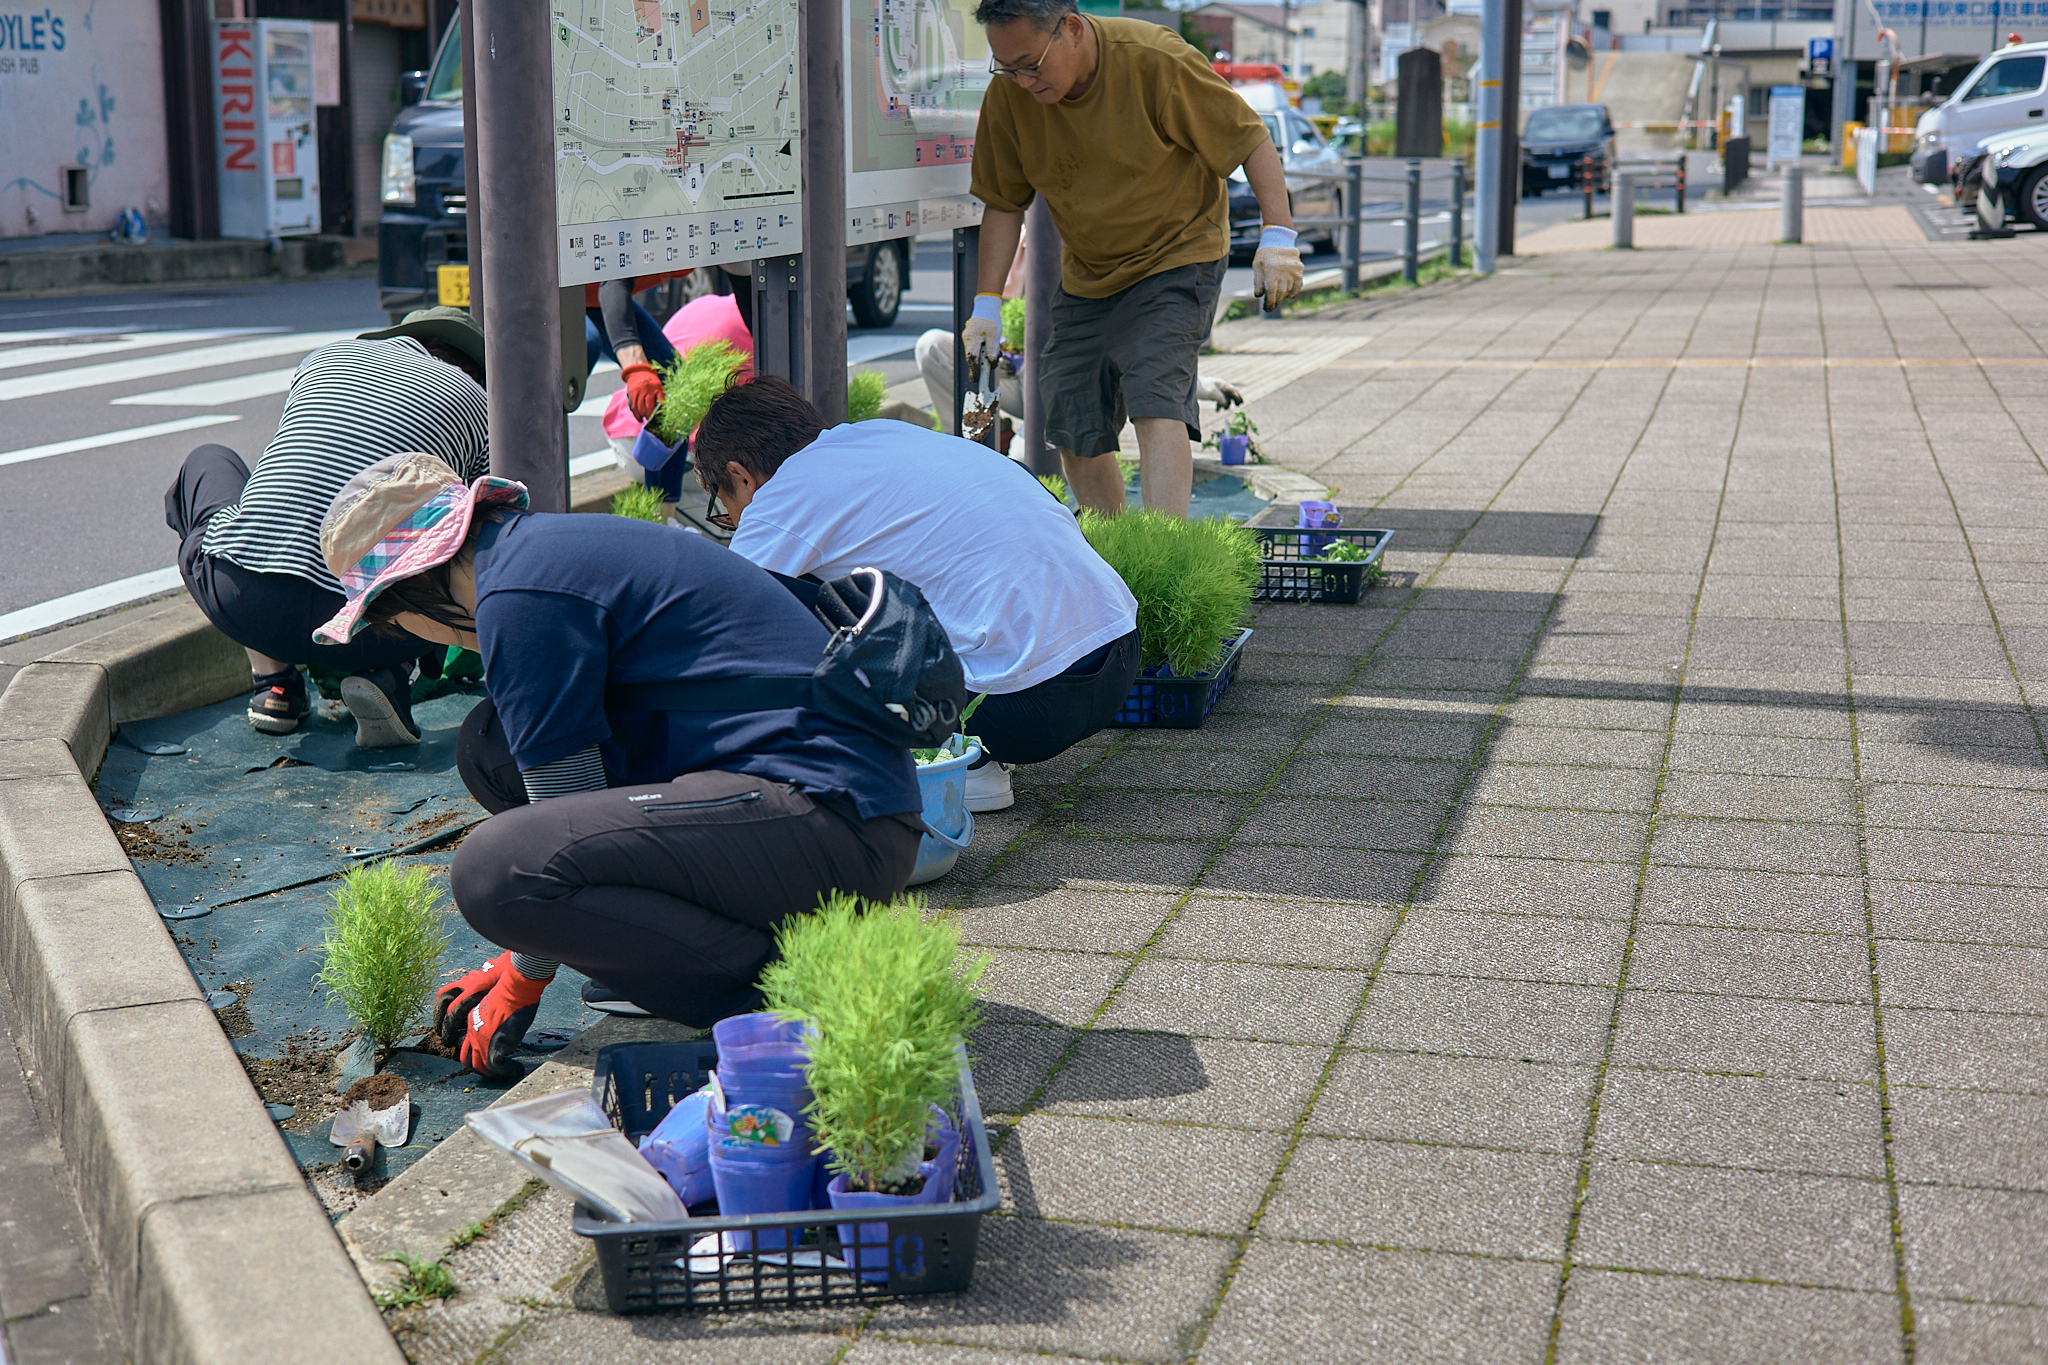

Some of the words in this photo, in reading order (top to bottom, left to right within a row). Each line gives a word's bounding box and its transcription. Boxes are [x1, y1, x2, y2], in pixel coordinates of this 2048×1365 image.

[1813, 40, 1829, 57] P
[19, 57, 40, 74] PUB
[218, 30, 258, 172] KIRIN
[267, 700, 287, 709] HUNTER
[1160, 693, 1189, 715] 01
